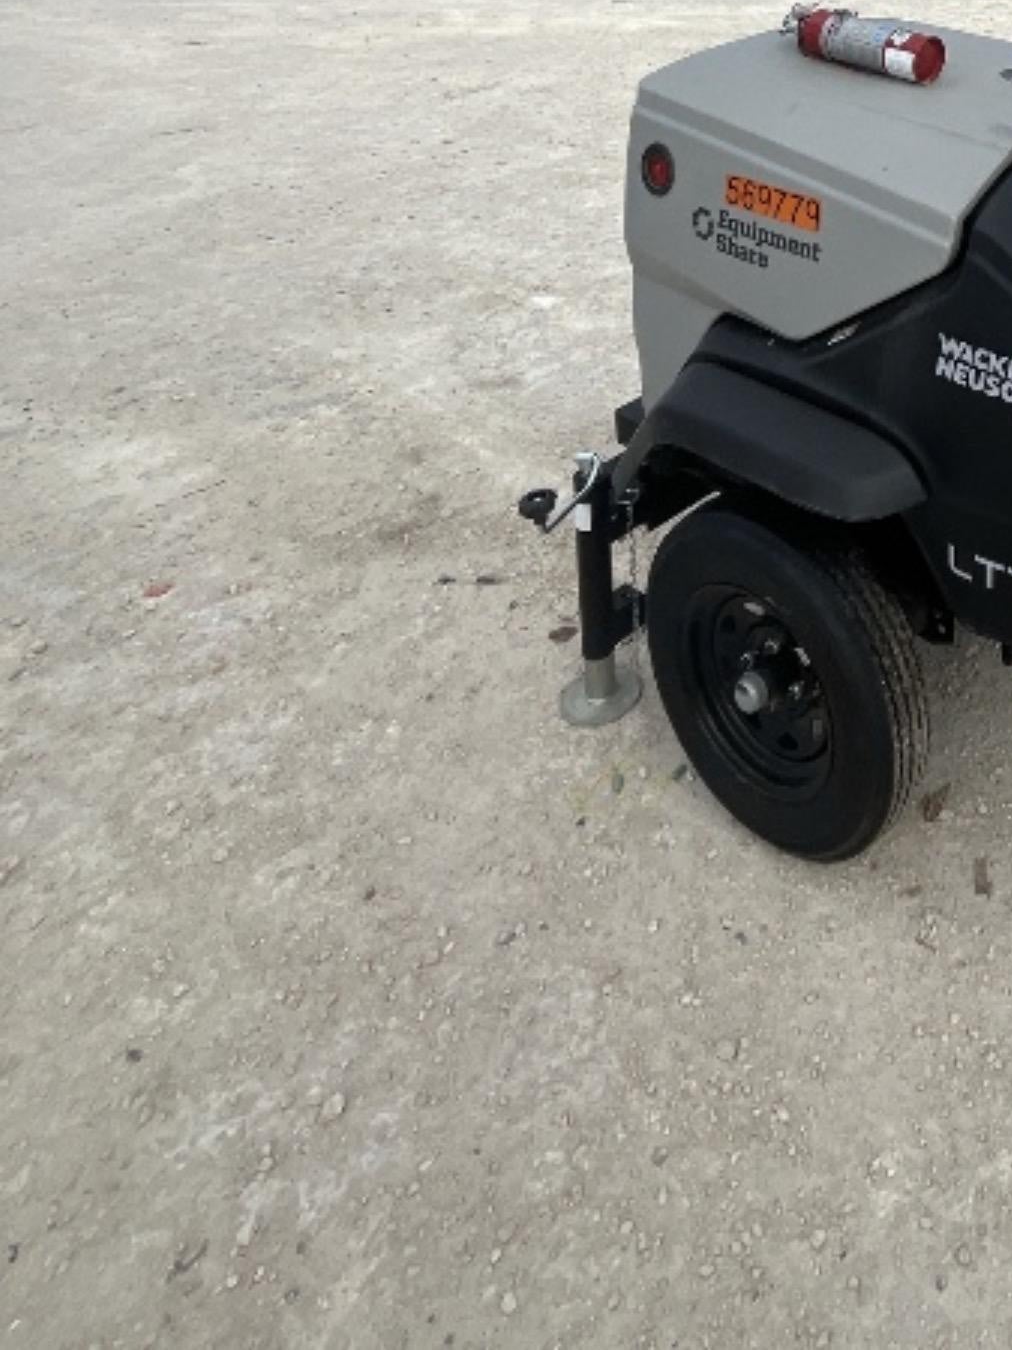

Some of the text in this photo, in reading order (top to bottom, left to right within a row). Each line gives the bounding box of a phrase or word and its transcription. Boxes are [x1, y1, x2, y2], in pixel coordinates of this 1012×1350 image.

[726, 176, 820, 231] 569779
[716, 233, 769, 268] Share
[718, 209, 821, 262] Equipment
